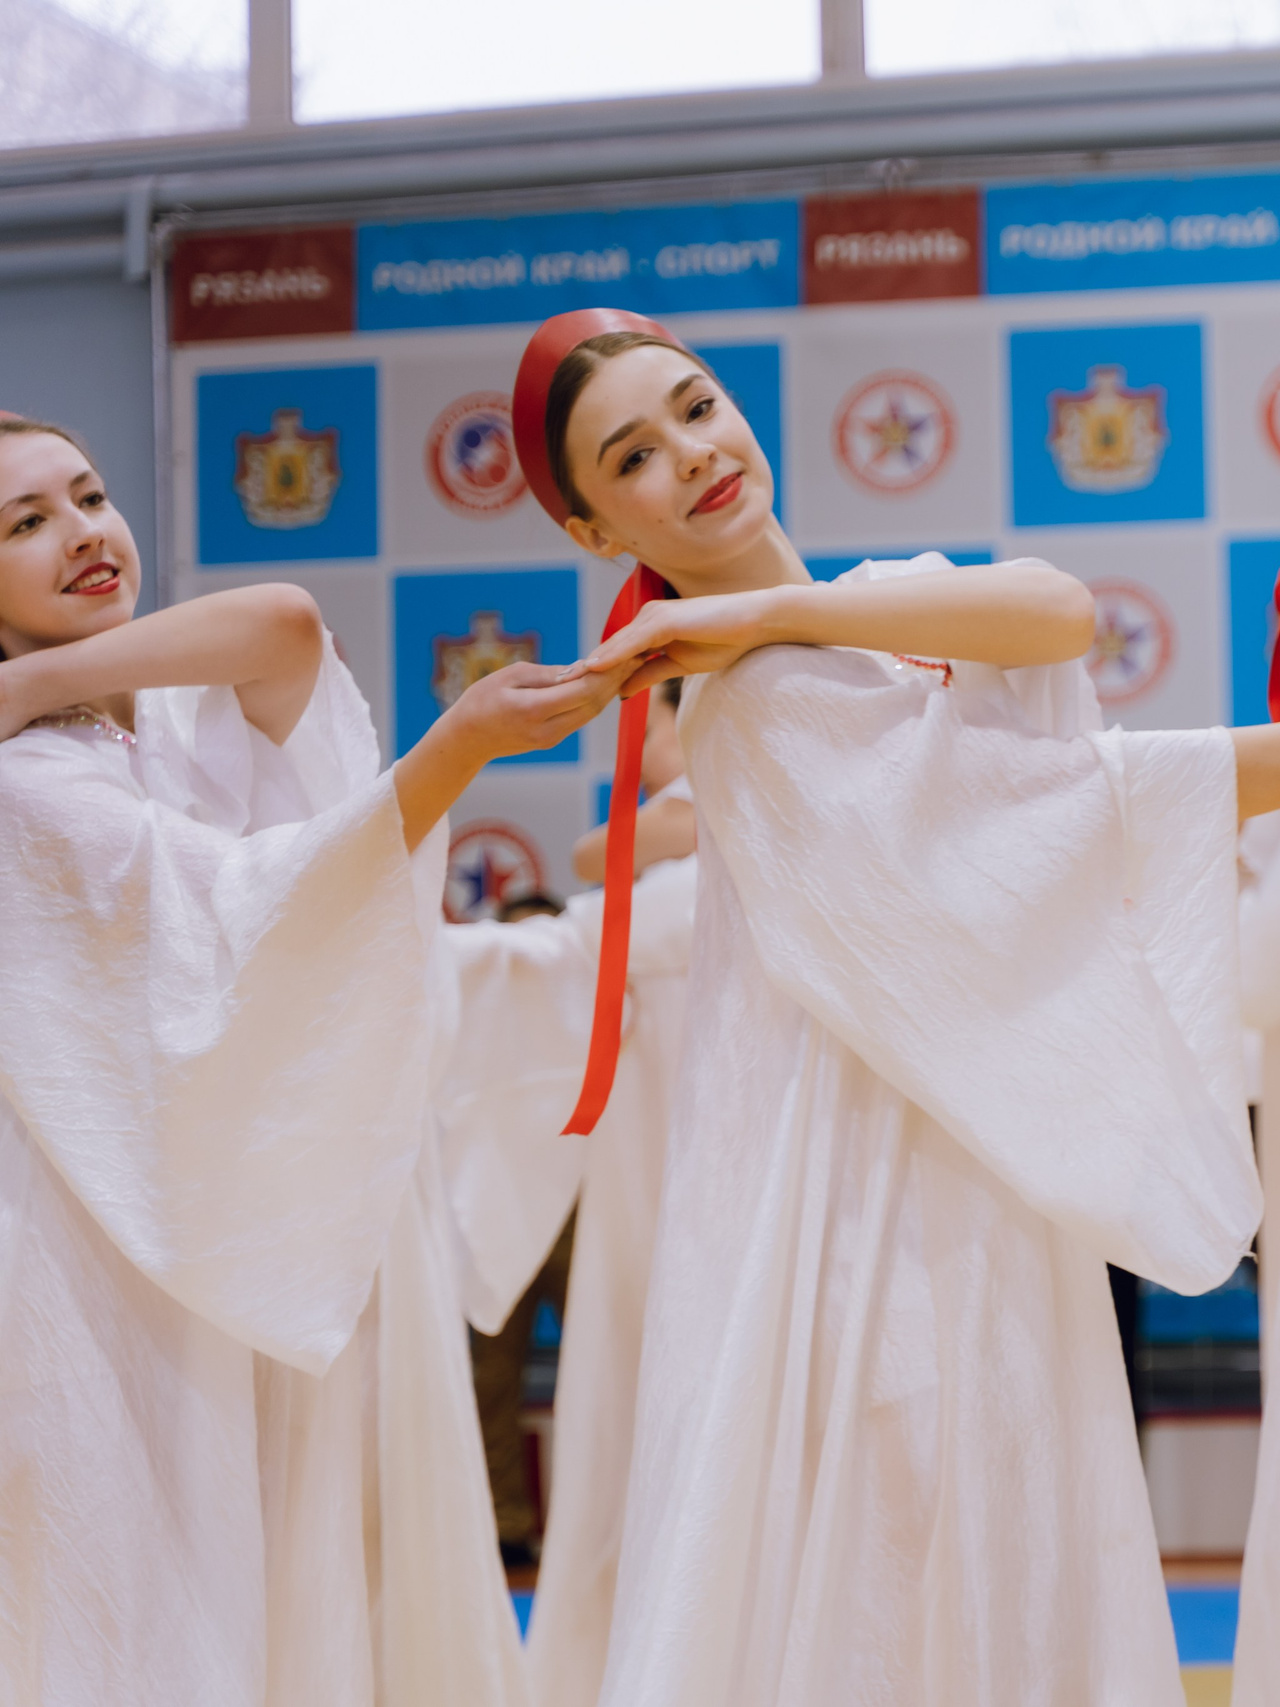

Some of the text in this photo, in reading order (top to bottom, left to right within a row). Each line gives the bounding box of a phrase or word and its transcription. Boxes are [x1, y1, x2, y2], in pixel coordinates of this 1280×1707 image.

[815, 227, 970, 271] РЯЗАНЬ
[1001, 213, 1166, 260] РОДНОЙ
[1171, 207, 1279, 250] КРАЙ
[191, 267, 331, 307] РЯЗАНЬ
[372, 250, 526, 295] РОДНОЙ
[530, 244, 629, 286] КРАЙ
[655, 239, 780, 279] СПОРТ
